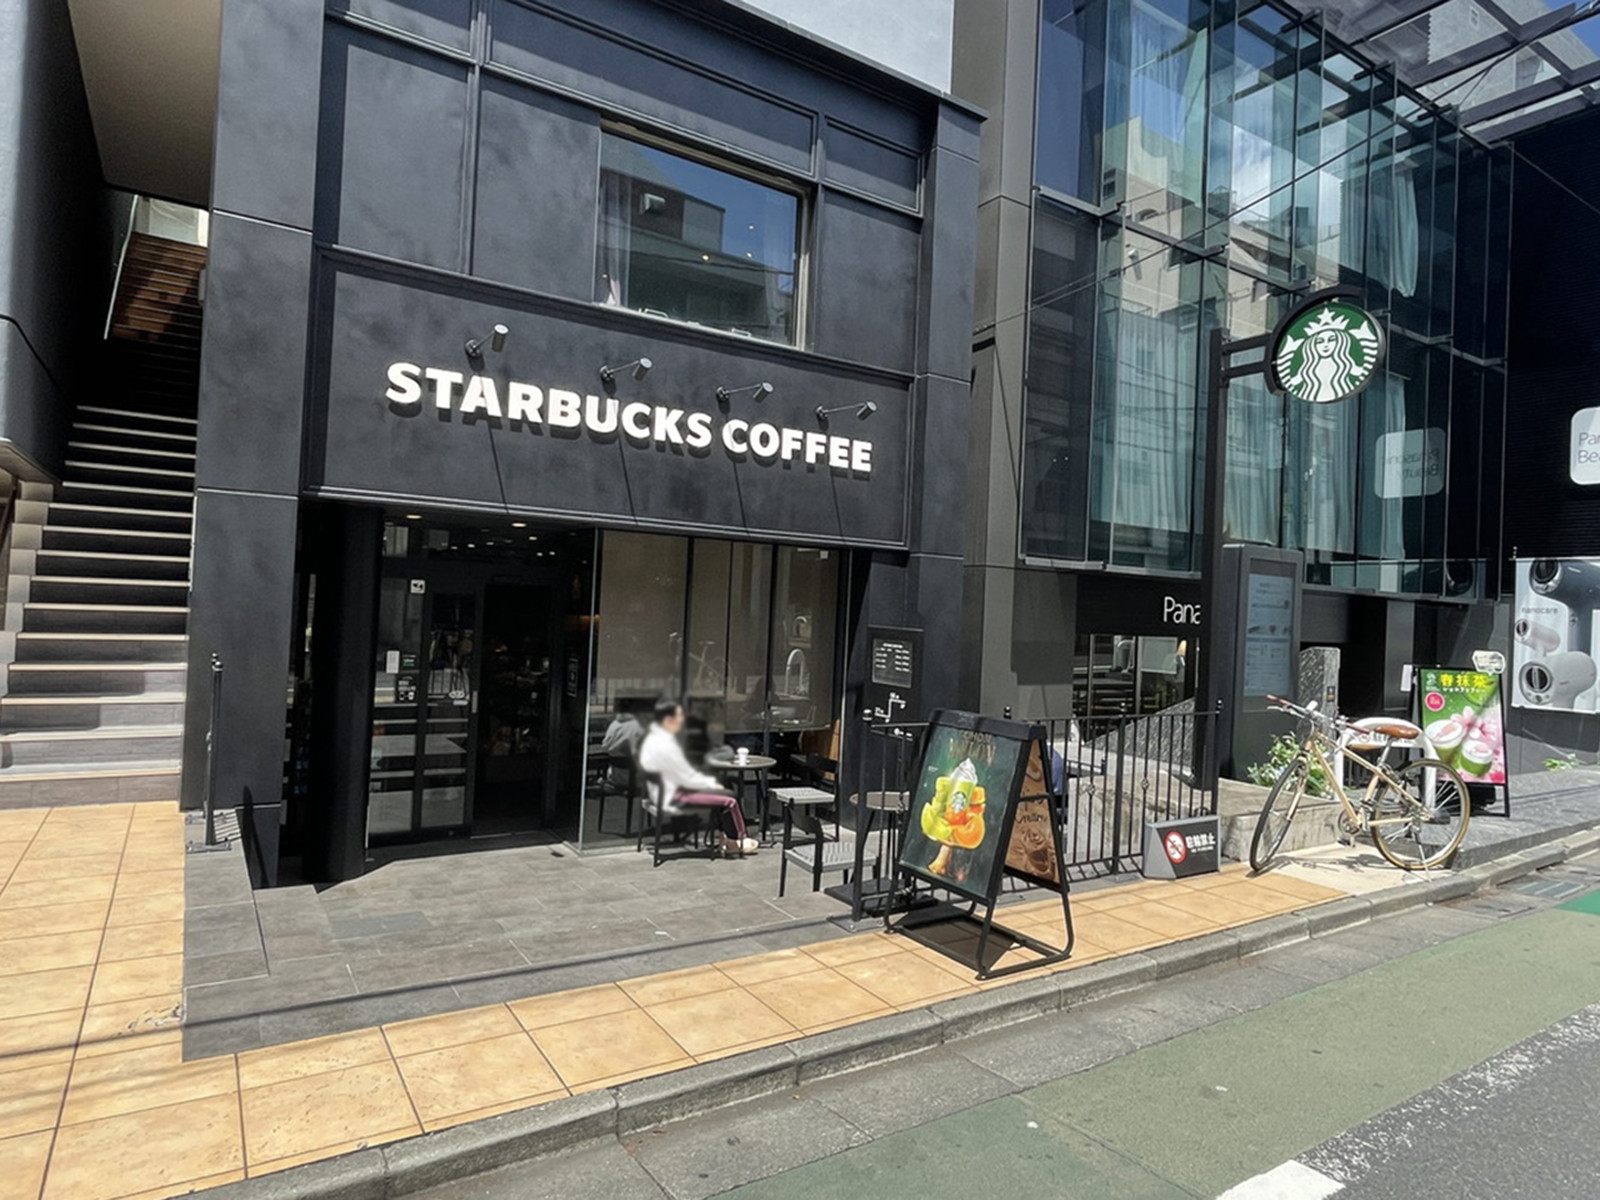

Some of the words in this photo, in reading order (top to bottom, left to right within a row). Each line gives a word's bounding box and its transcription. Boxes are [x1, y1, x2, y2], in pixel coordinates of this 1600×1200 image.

[385, 362, 712, 448] STARBUCKS
[722, 419, 873, 472] COFFEE
[1578, 449, 1600, 464] Be
